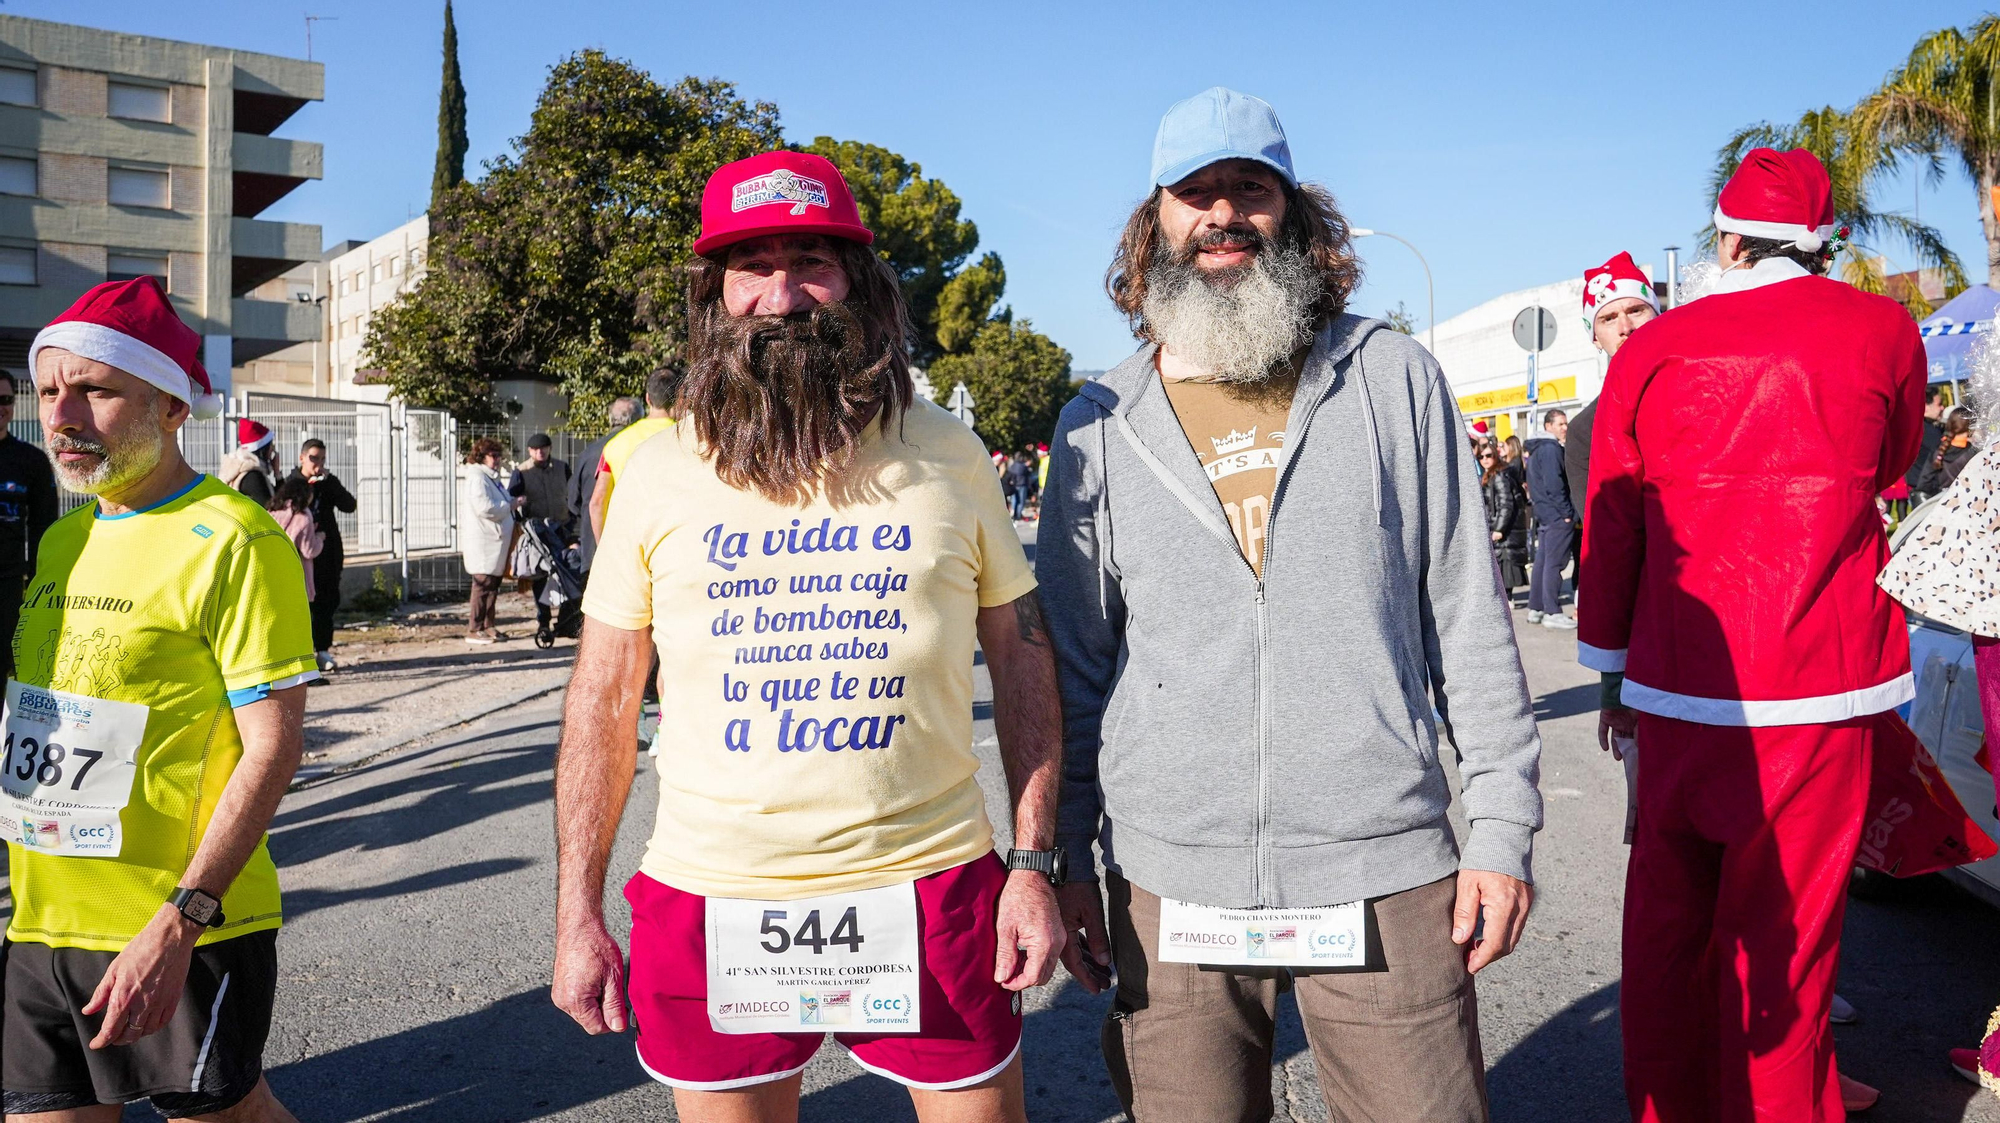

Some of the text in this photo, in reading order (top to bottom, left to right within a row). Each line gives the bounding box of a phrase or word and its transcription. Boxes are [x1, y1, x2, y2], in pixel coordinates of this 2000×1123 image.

[736, 180, 825, 197] BUBBA GUMP
[736, 191, 777, 208] SHRIMP
[1210, 452, 1274, 477] T'S A
[702, 517, 911, 571] La vida es
[707, 566, 908, 599] como una caja
[43, 595, 133, 613] ANIVERSARIO
[711, 603, 908, 636] de bombones,
[735, 636, 889, 664] nunca sabes
[723, 671, 905, 712] lo que te va
[20, 697, 92, 718] populares
[724, 708, 905, 753] a tocar
[4, 732, 103, 791] 1387
[79, 828, 105, 837] GCC
[1219, 913, 1245, 921] PEDRO
[760, 906, 865, 954] 544
[1185, 932, 1237, 945] IMDECO
[1317, 934, 1346, 945] GCC
[744, 966, 768, 976] SAN
[770, 966, 836, 976] SILVESTRE
[838, 963, 913, 976] CORDOBESA
[777, 977, 871, 986] MARTÍN GARCÍA PÉREZ
[735, 1001, 790, 1013] IMDECO
[872, 999, 901, 1010] GCC
